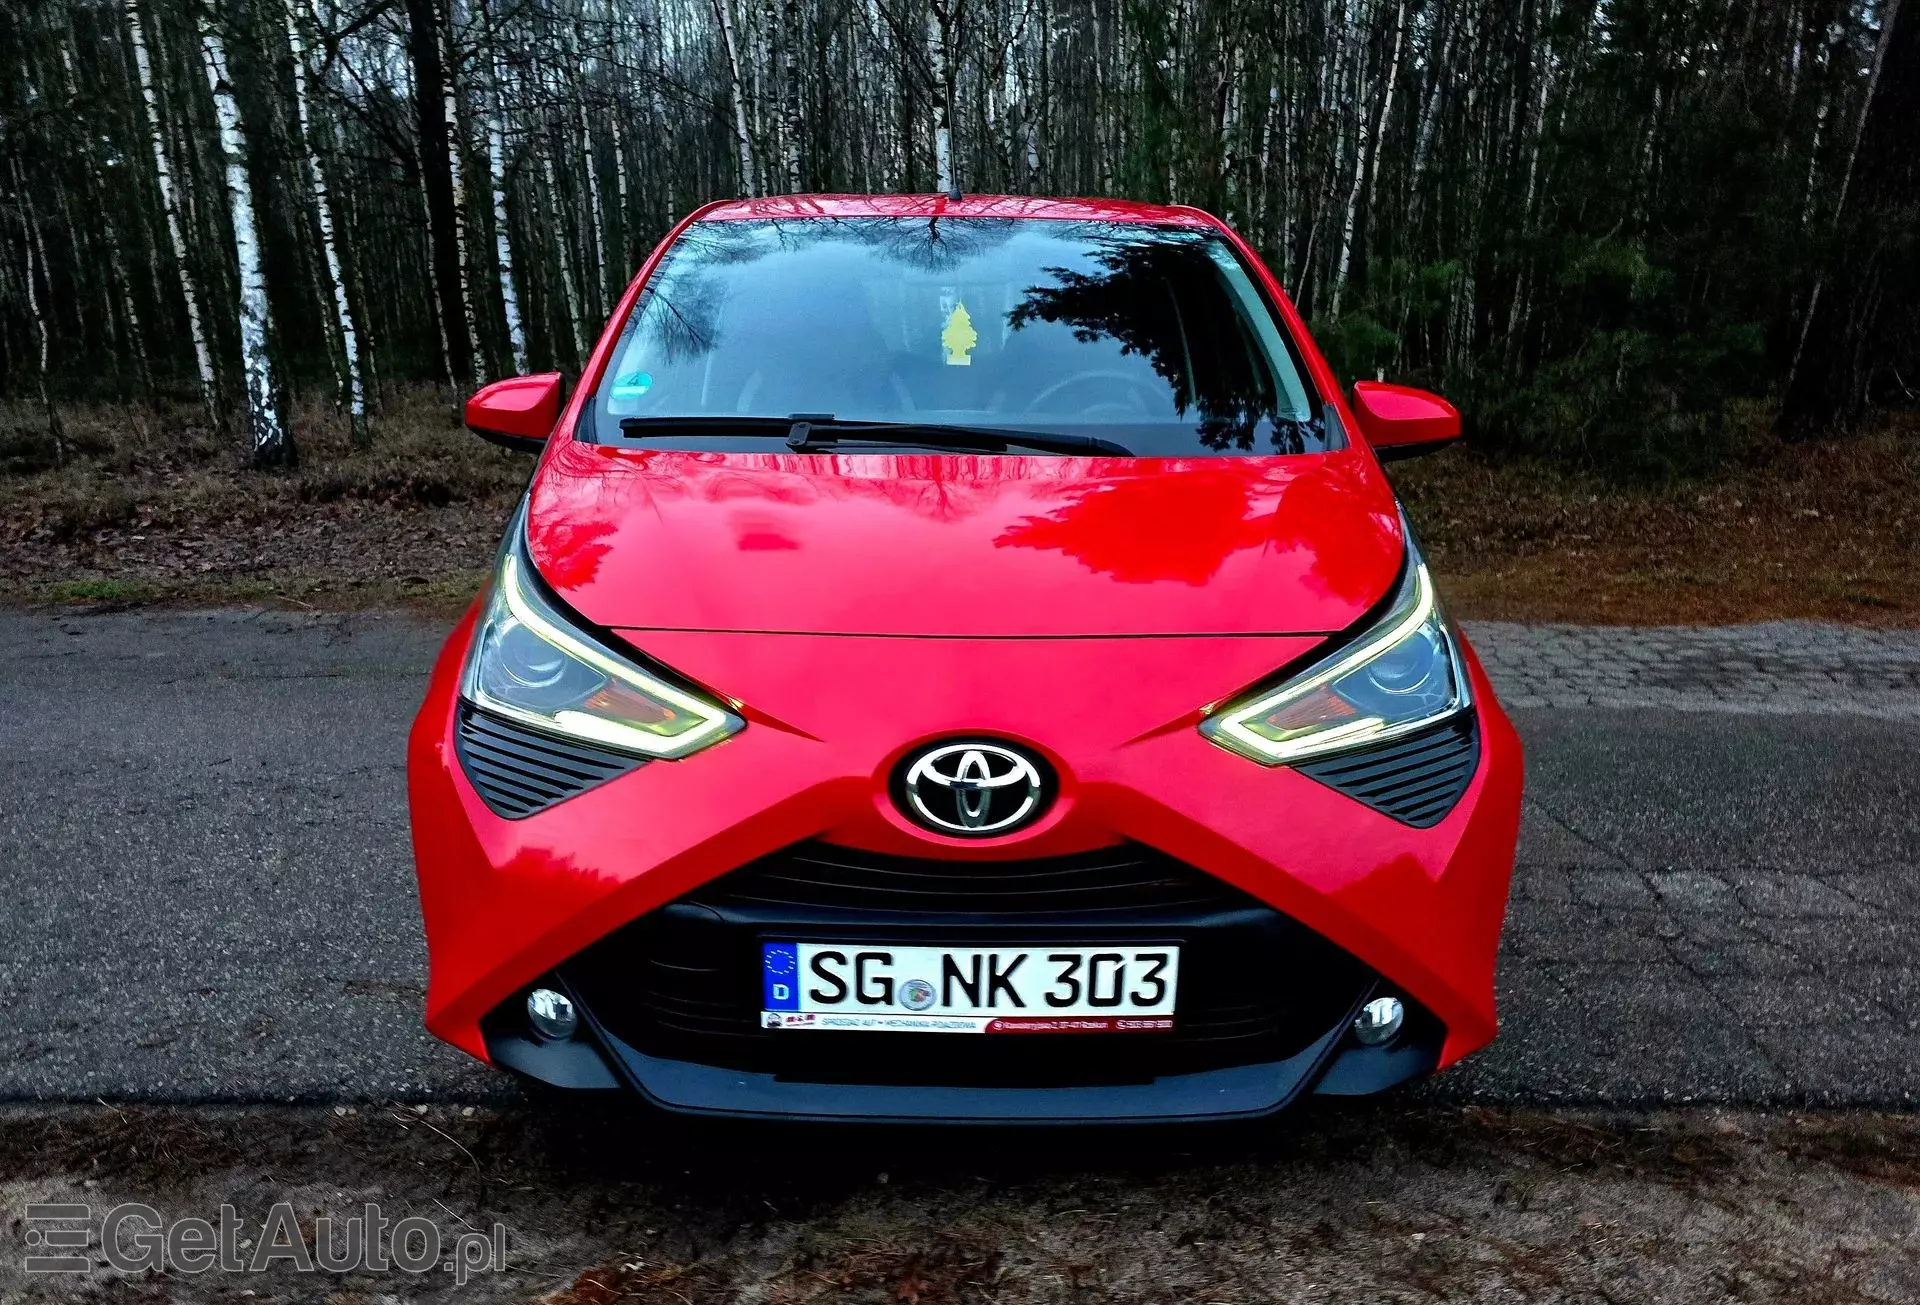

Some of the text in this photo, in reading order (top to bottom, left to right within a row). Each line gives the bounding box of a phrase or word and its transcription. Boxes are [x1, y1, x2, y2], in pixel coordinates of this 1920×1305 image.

[773, 983, 790, 1000] D
[810, 950, 1168, 1008] SG NK 303
